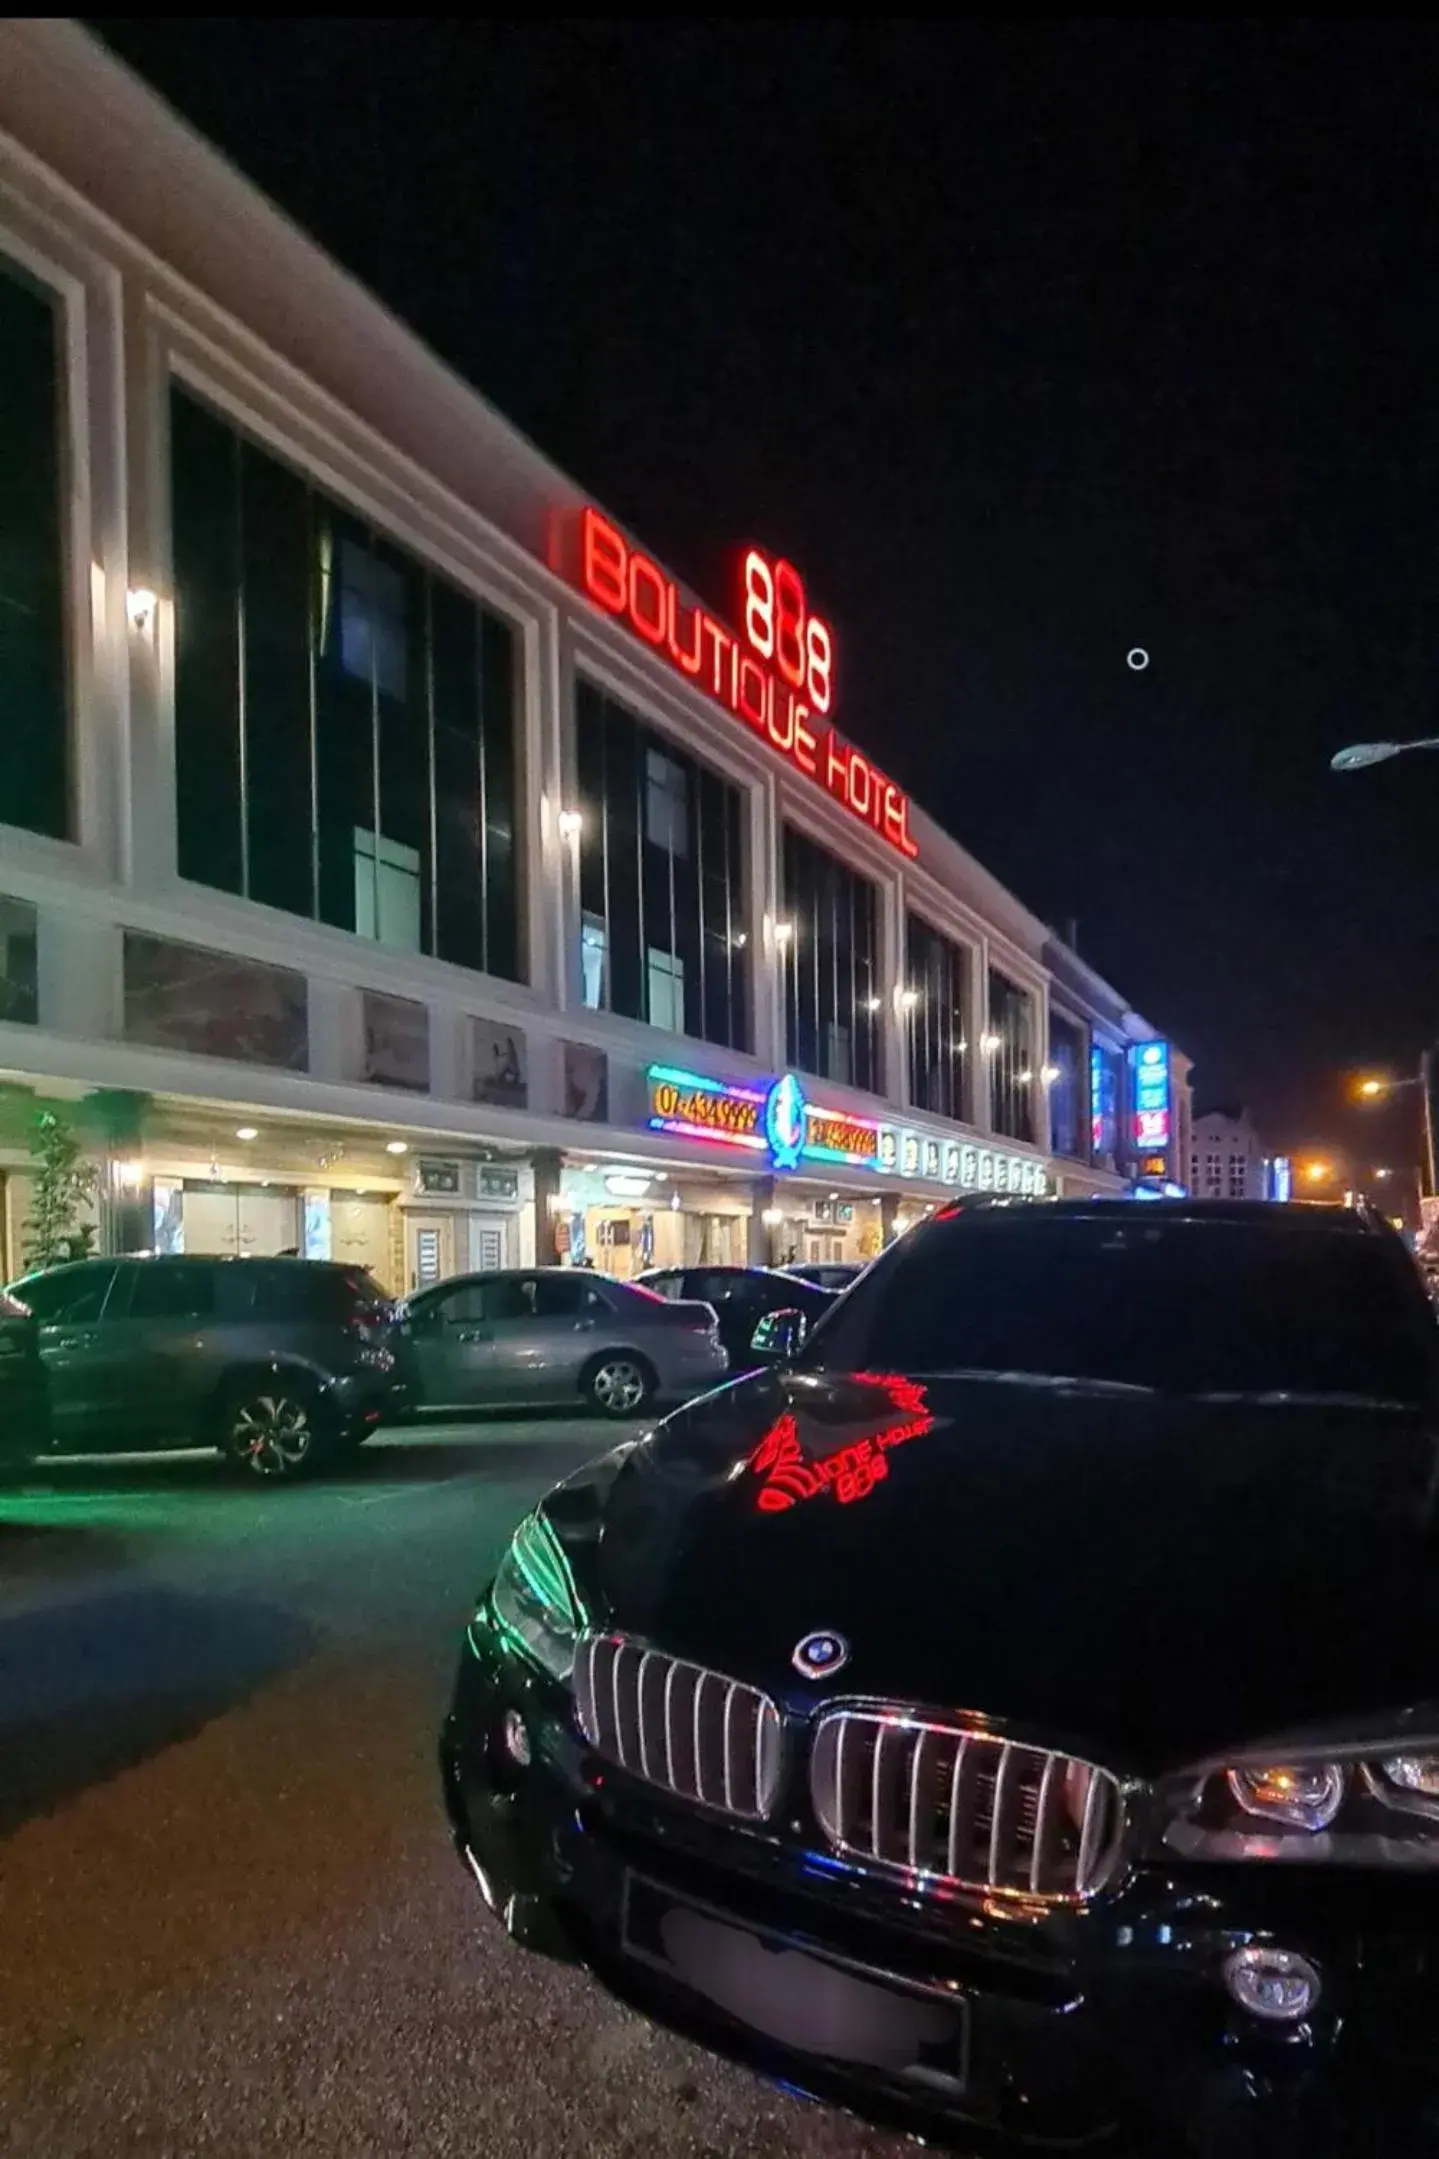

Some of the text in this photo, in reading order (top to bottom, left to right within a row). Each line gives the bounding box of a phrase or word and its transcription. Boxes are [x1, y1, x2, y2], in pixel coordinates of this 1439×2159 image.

[583, 507, 918, 856] BOUTIQUE HOTEL
[744, 550, 831, 713] 888
